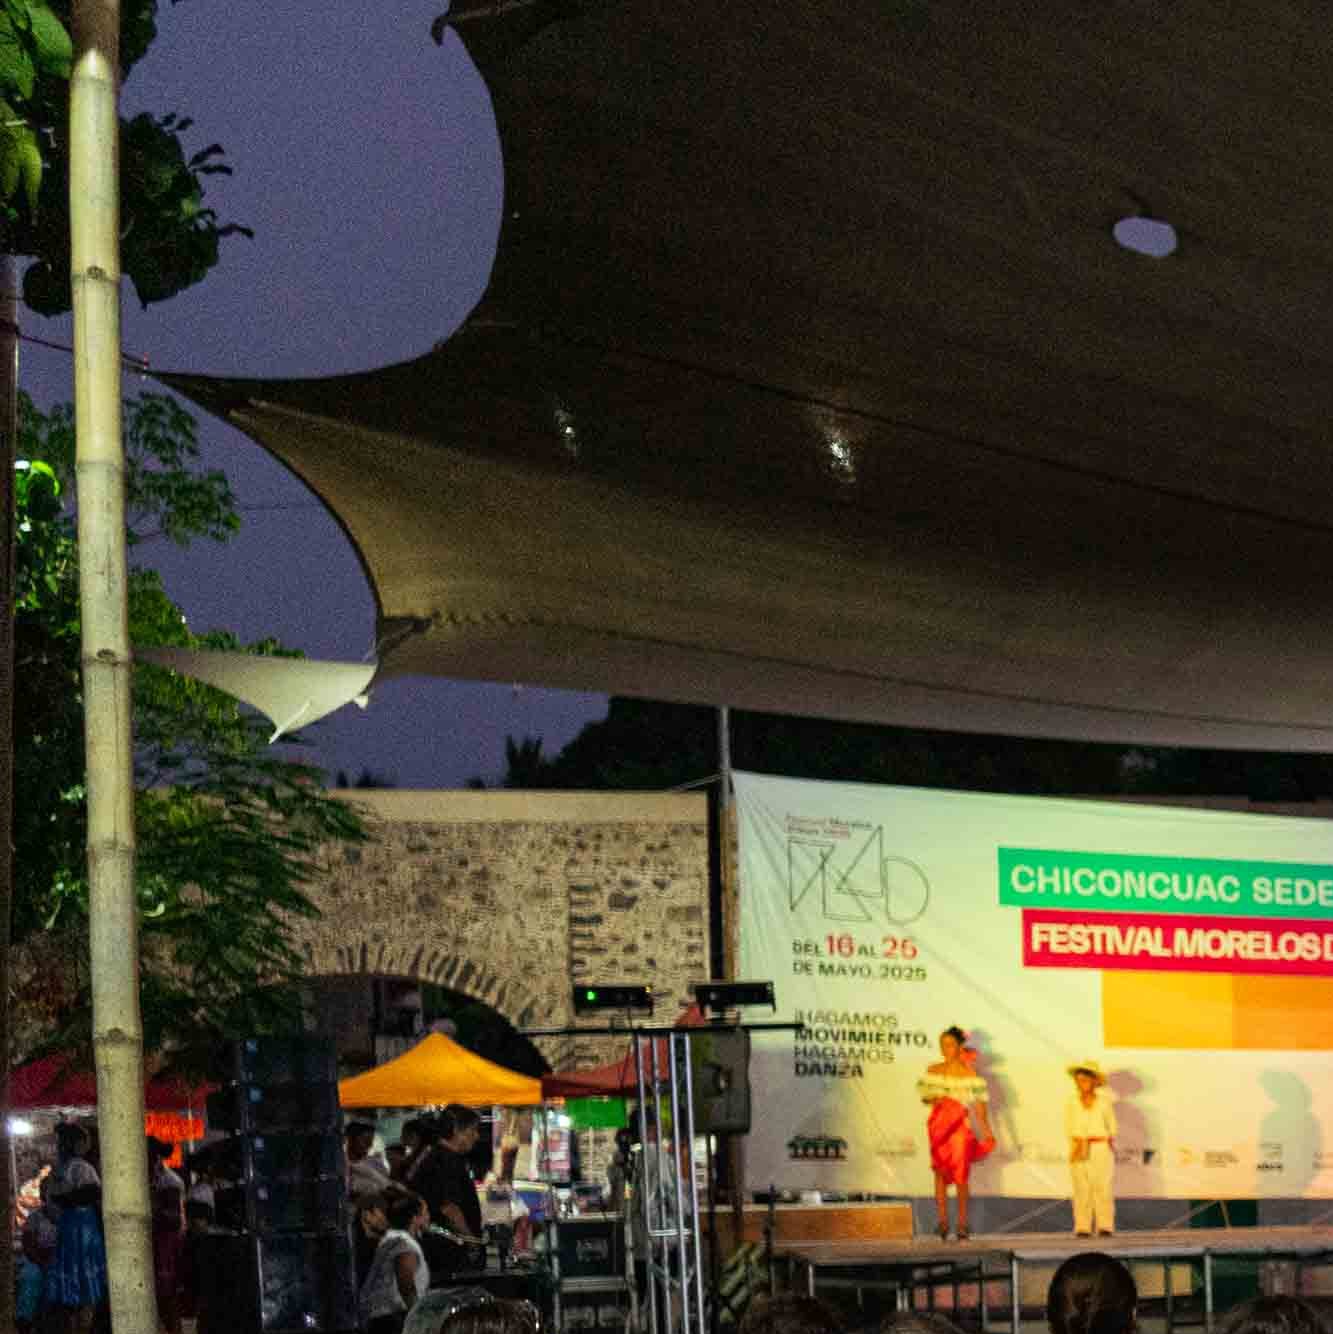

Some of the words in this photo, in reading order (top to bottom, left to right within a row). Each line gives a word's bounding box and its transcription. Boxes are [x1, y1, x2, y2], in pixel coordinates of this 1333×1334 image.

[1010, 863, 1241, 903] CHICONCUAC
[792, 939, 822, 958] DEL
[825, 933, 855, 959] 16
[857, 943, 878, 959] AL
[881, 936, 918, 961] 25
[1031, 922, 1172, 958] FESTIVAL
[792, 961, 814, 976] DE
[880, 964, 927, 982] 2025
[794, 1062, 864, 1080] DANZA
